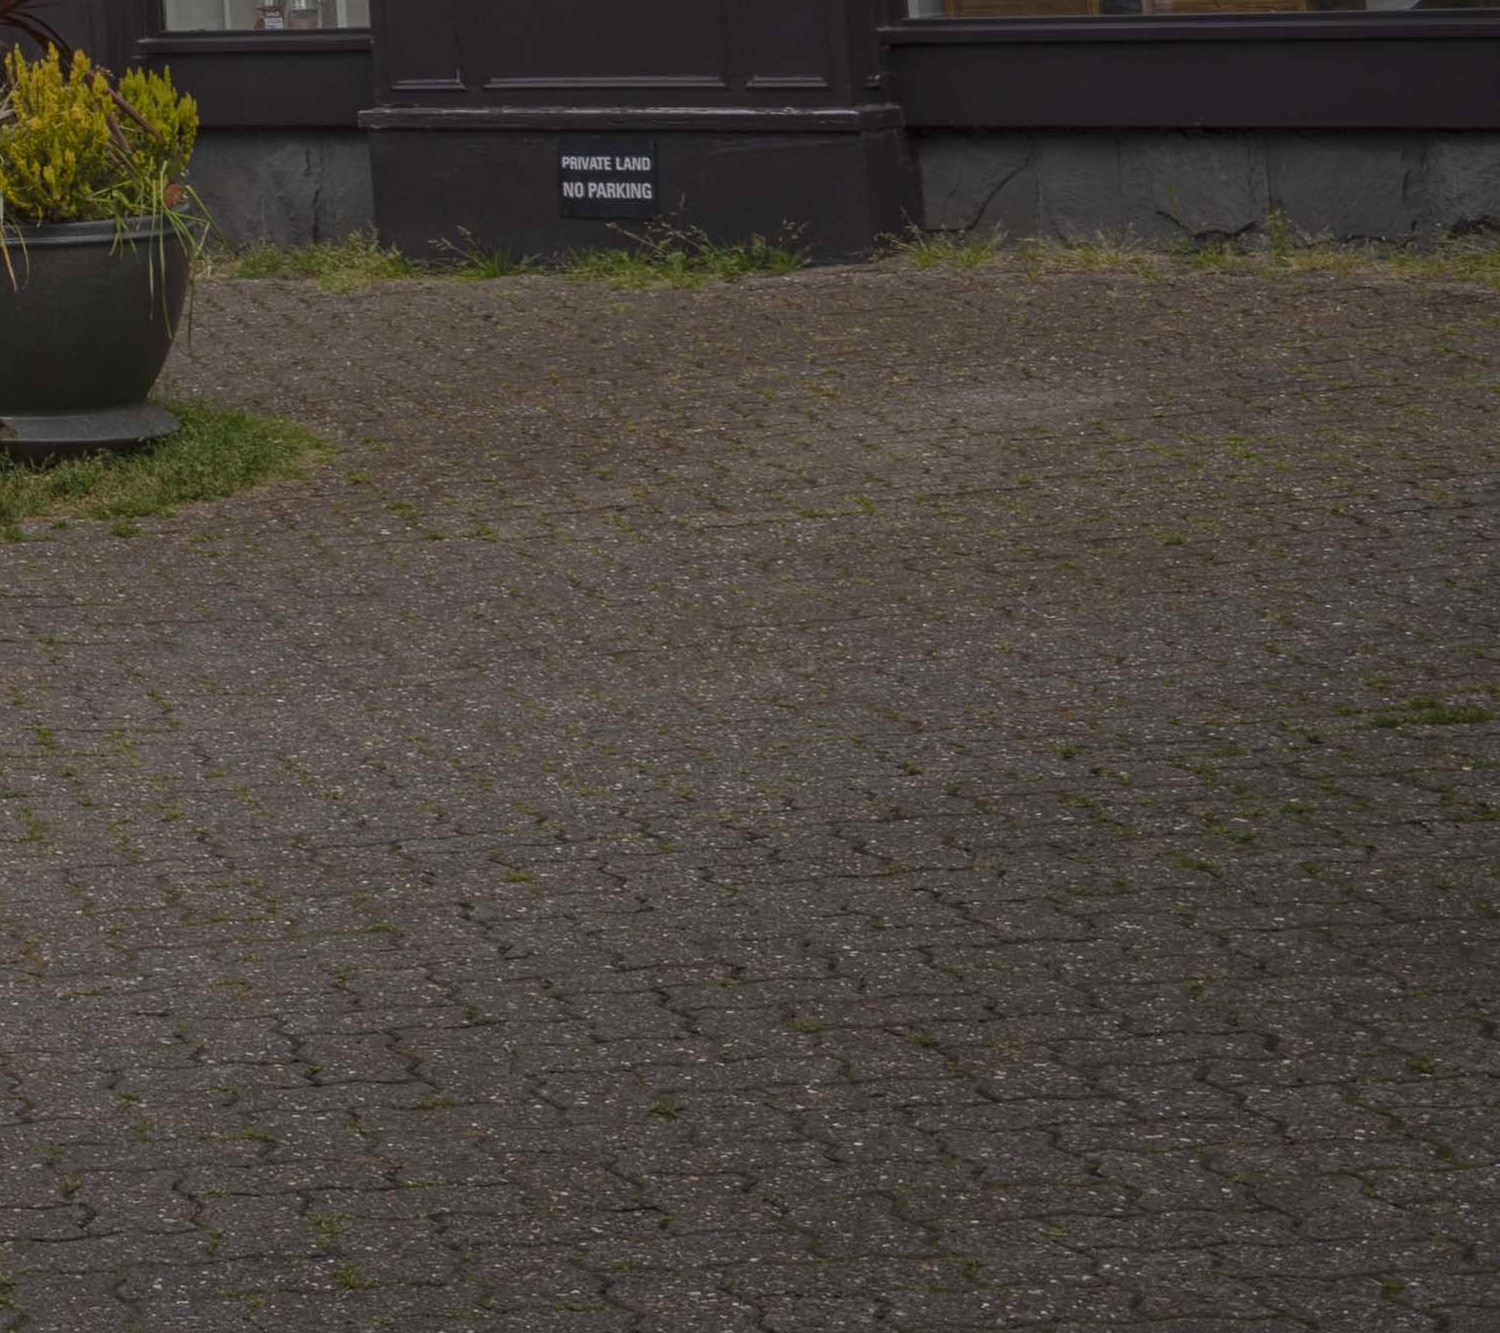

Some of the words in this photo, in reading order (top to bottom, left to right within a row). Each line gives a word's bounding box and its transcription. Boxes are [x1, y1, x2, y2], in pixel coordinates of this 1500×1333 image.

[561, 156, 612, 171] PRIVATE
[616, 156, 651, 171] LAND
[563, 181, 585, 198] NO
[588, 182, 653, 200] PARKING
